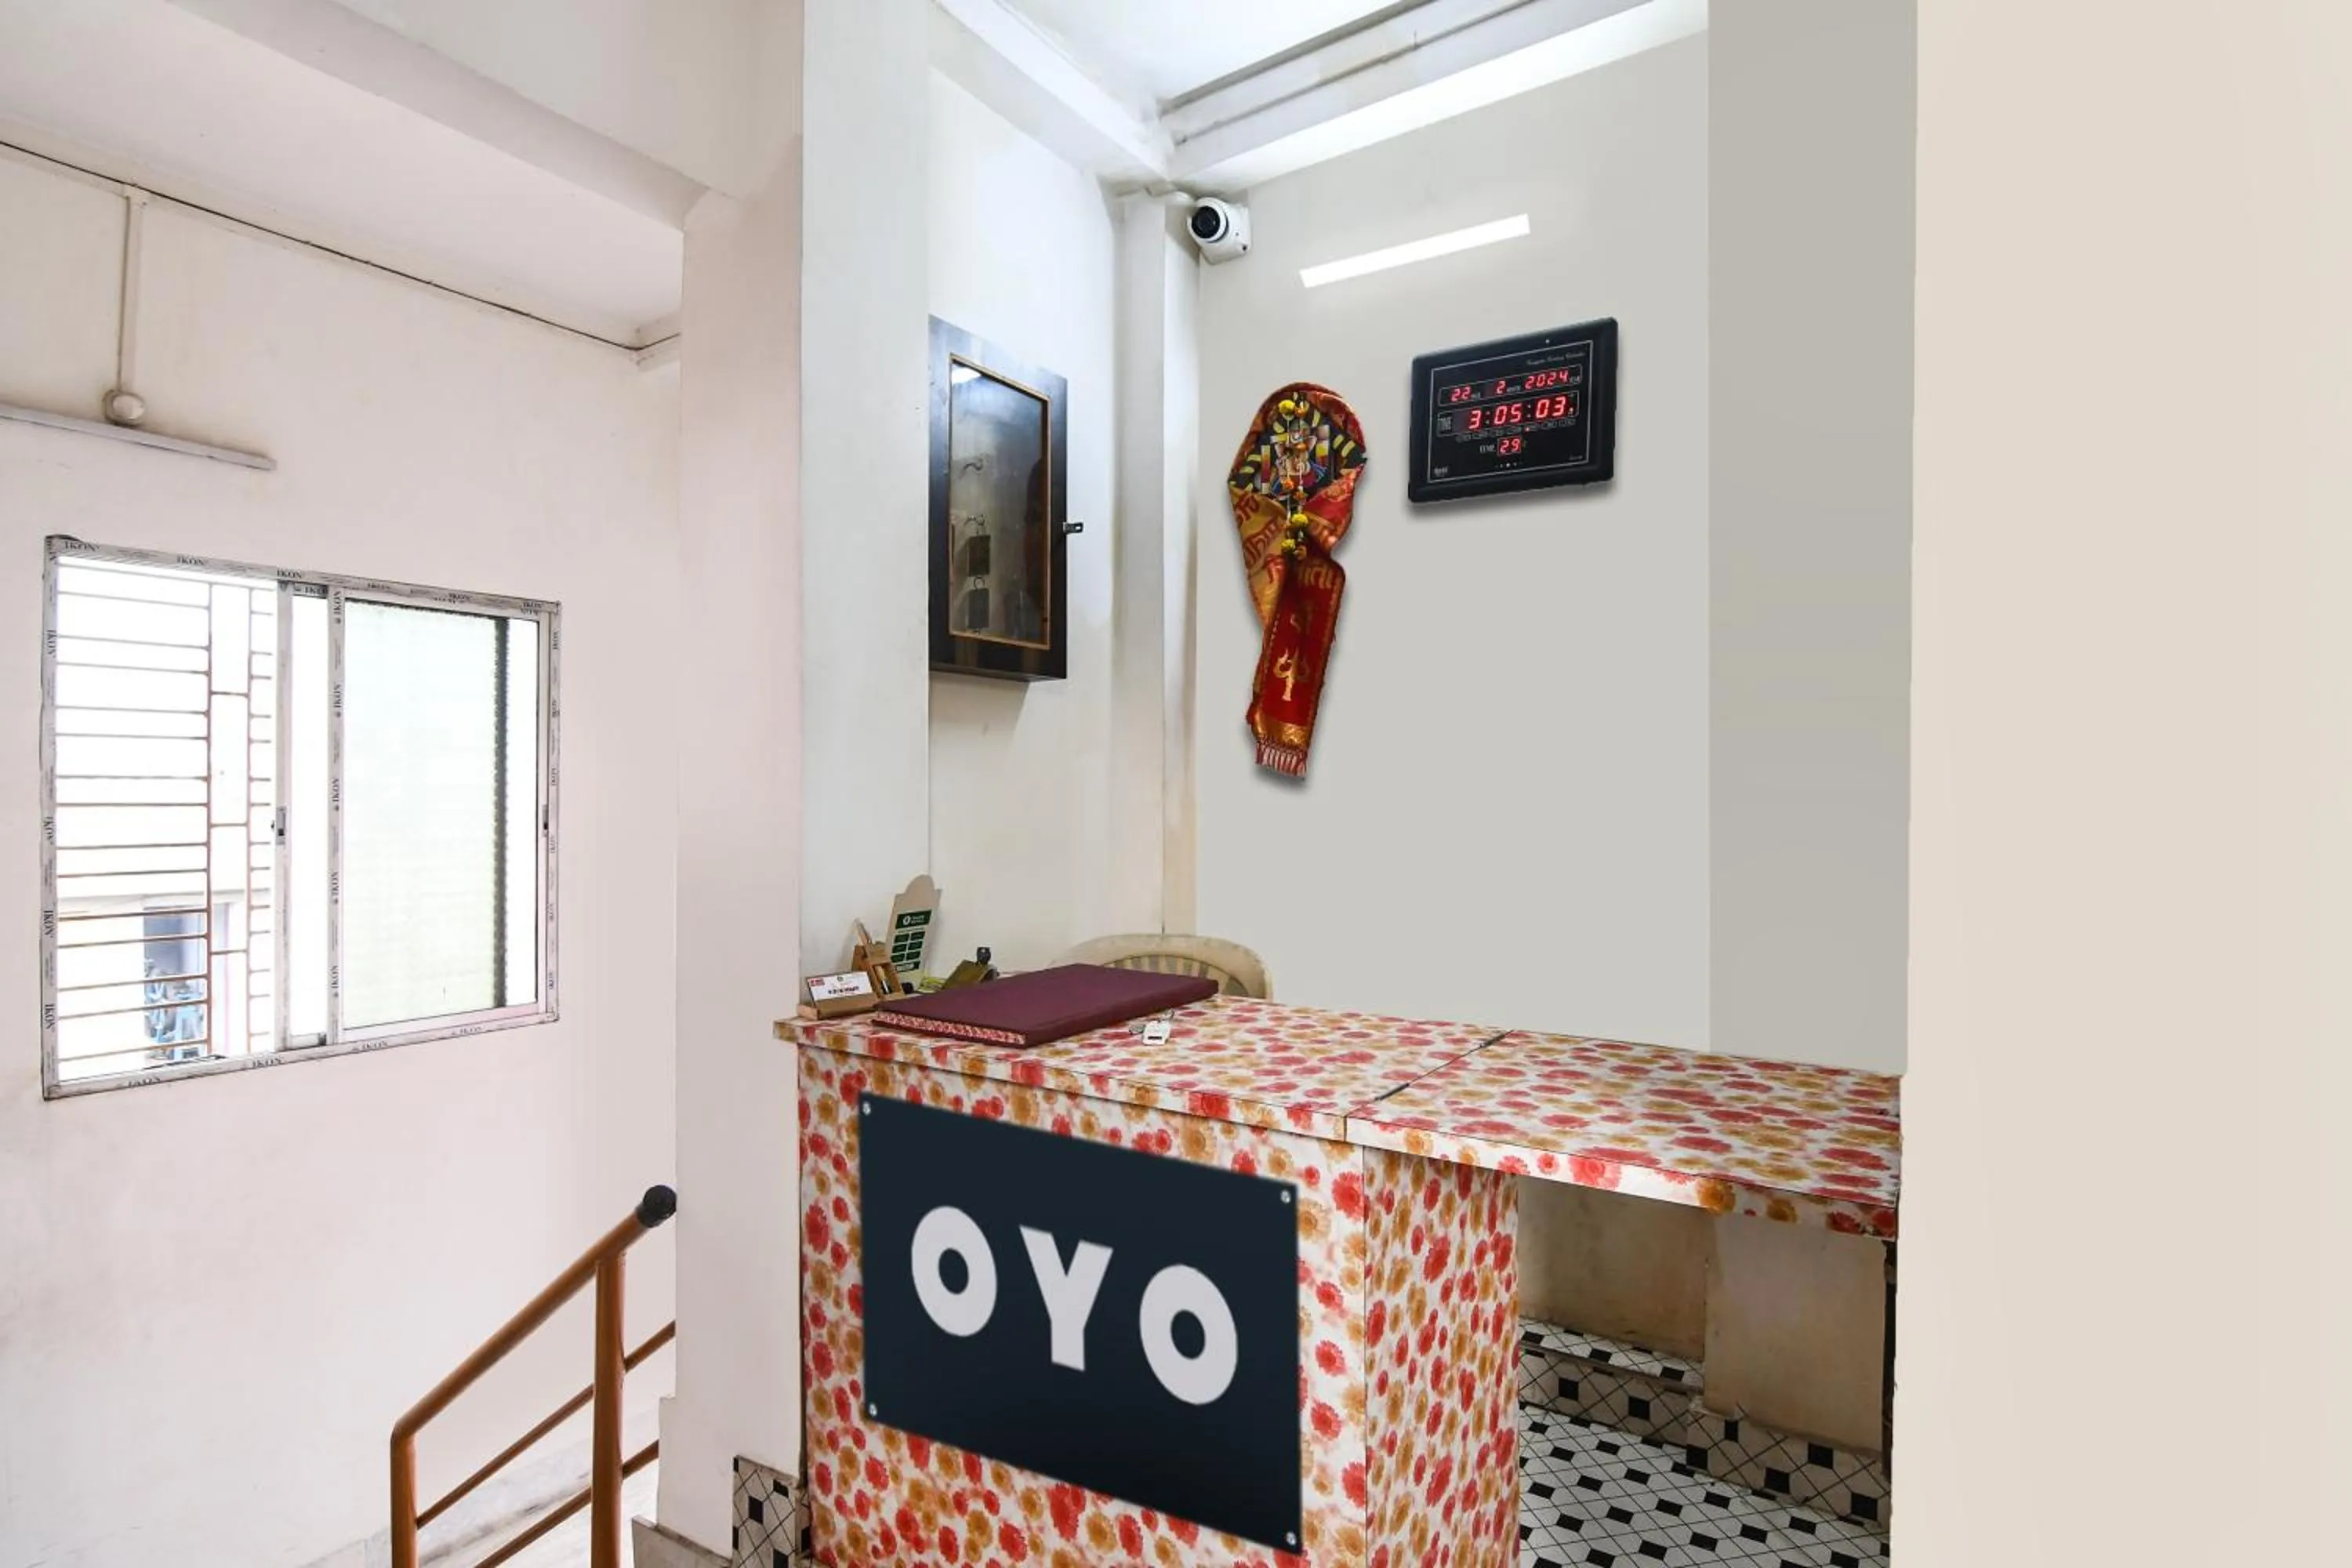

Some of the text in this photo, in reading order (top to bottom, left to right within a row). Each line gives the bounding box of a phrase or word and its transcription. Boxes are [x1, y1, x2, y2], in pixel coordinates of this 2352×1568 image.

[1451, 387, 1471, 401] 22
[1497, 380, 1506, 394] 2
[1525, 370, 1568, 390] 2024
[1500, 438, 1520, 453] 29
[277, 569, 302, 579] IKON
[44, 910, 54, 935] IKON
[45, 1004, 55, 1029] IKON
[911, 1206, 1238, 1406] OYO
